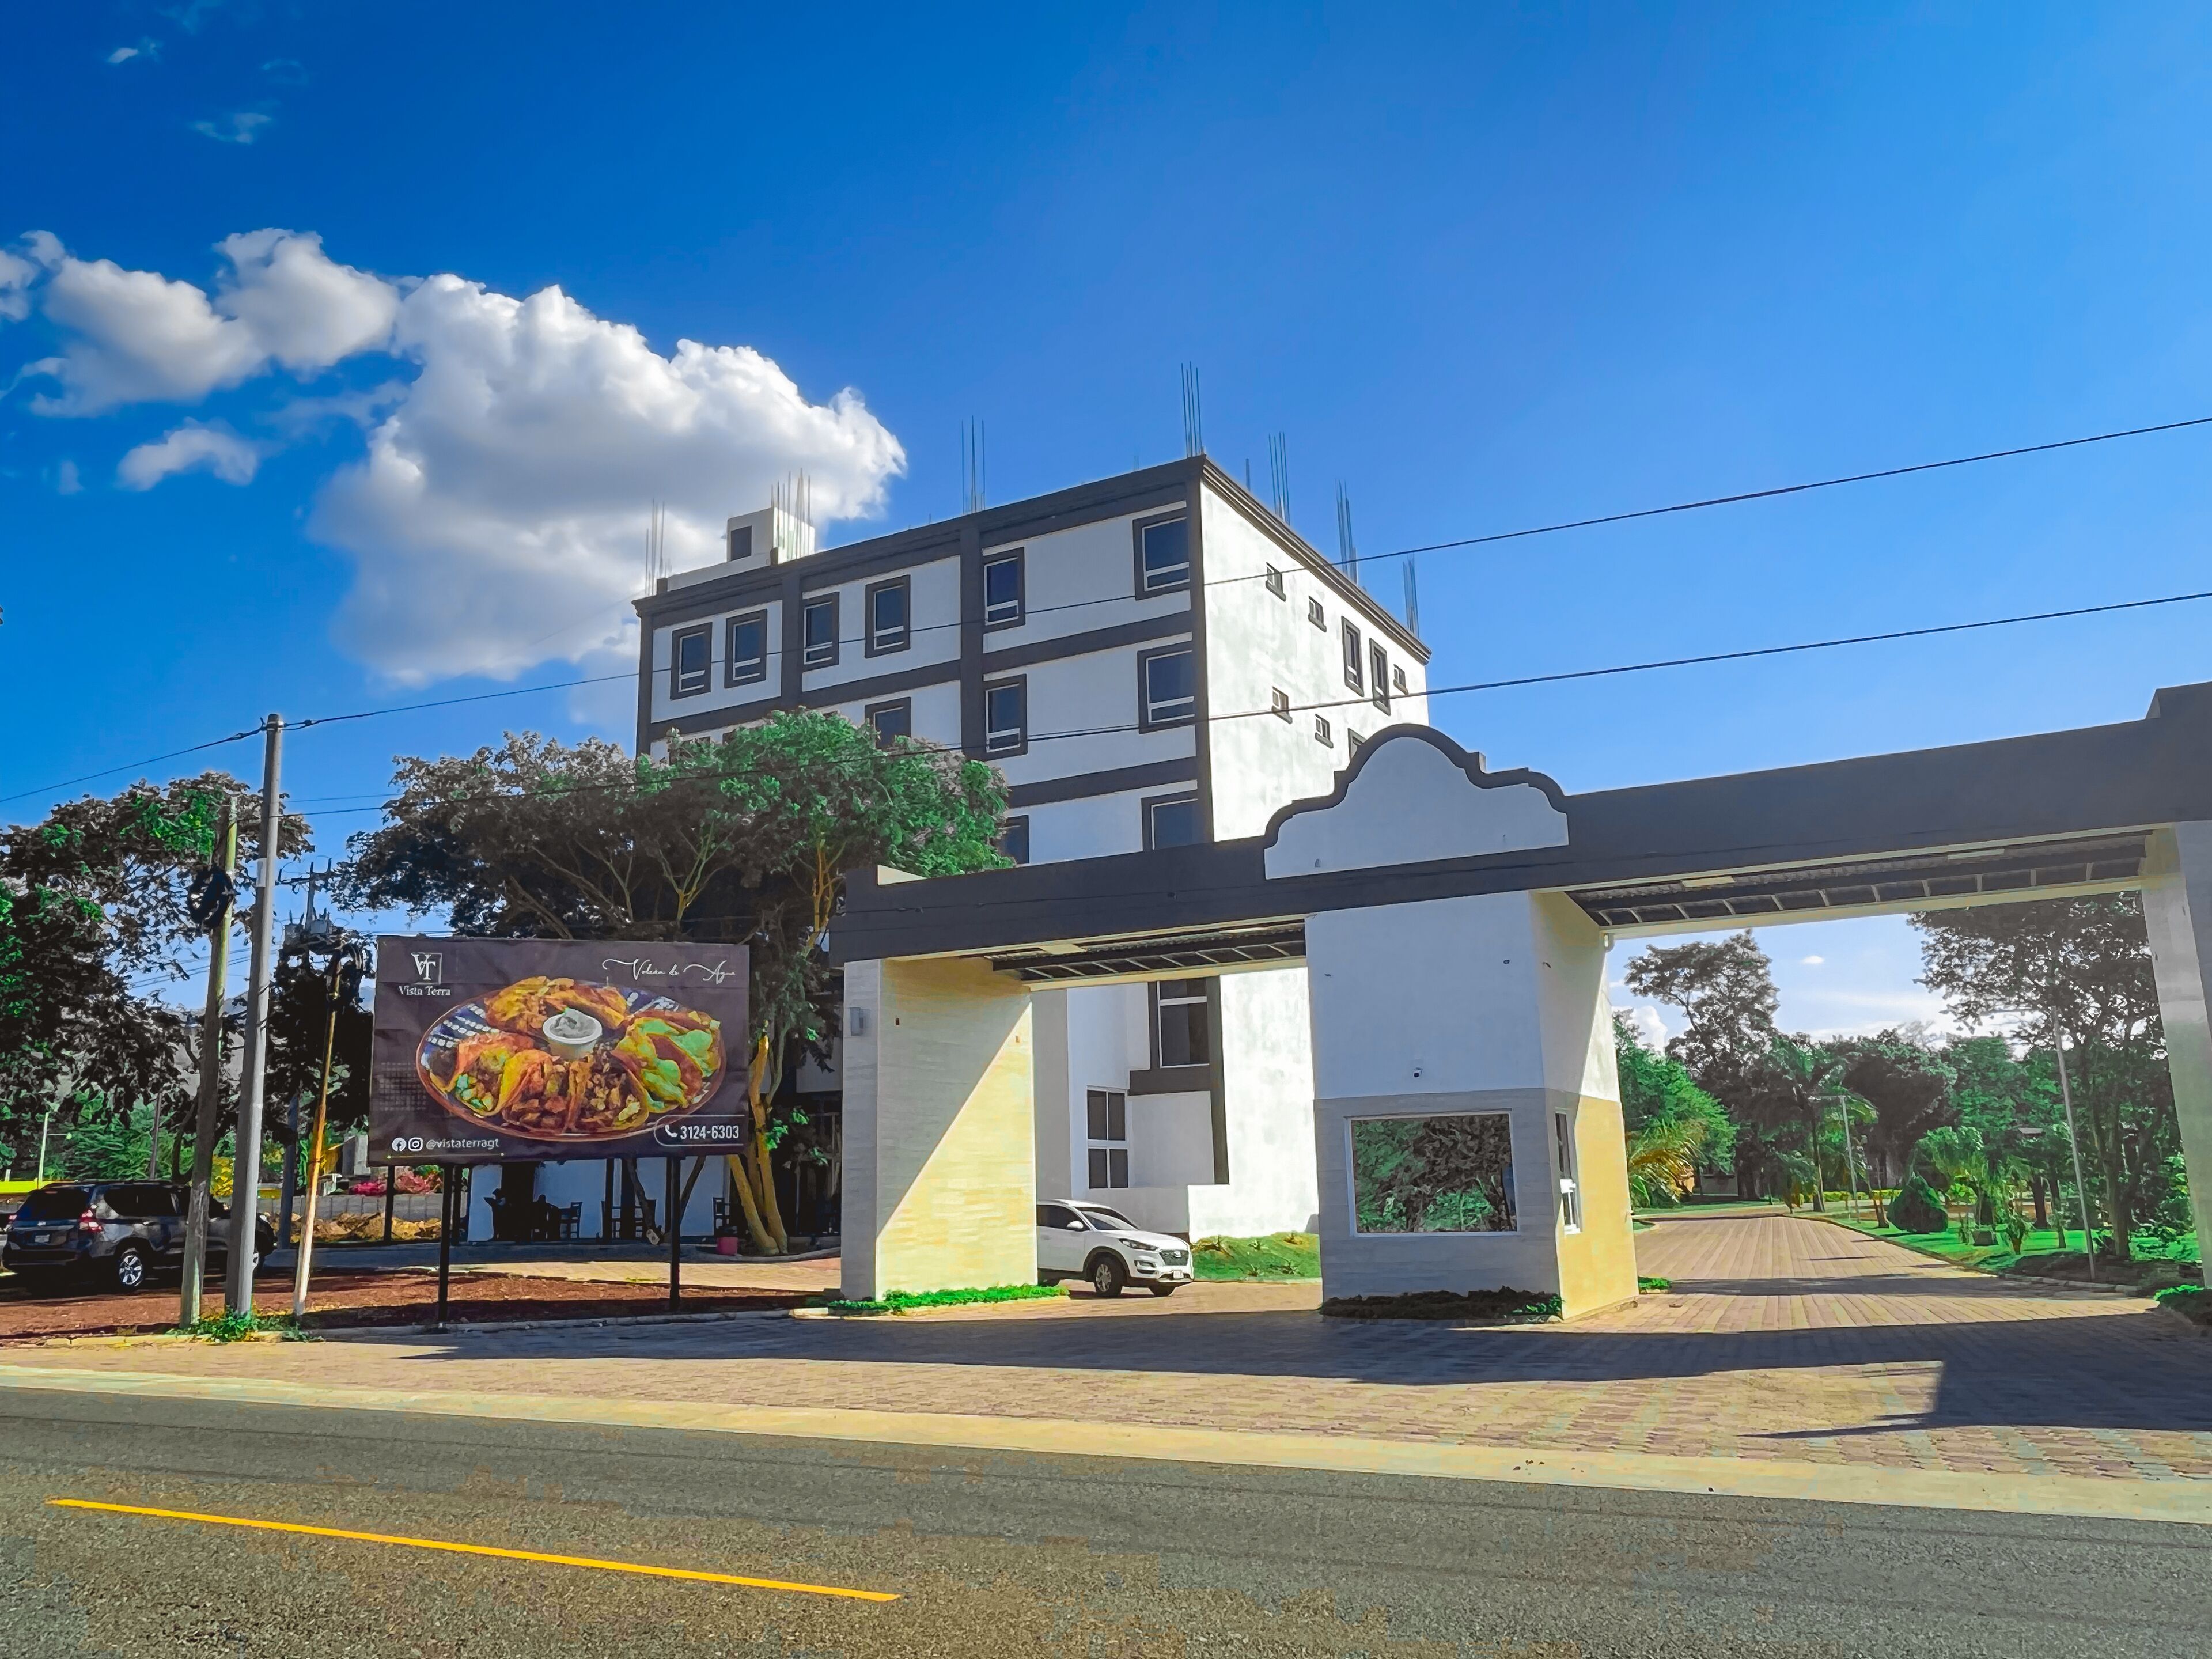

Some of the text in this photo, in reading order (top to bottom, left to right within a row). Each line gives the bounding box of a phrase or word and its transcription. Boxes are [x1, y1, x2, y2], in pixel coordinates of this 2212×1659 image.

[399, 985, 451, 996] Vista Terra
[680, 1125, 739, 1139] 3124-6303
[426, 1138, 499, 1150] @vistaterragt
